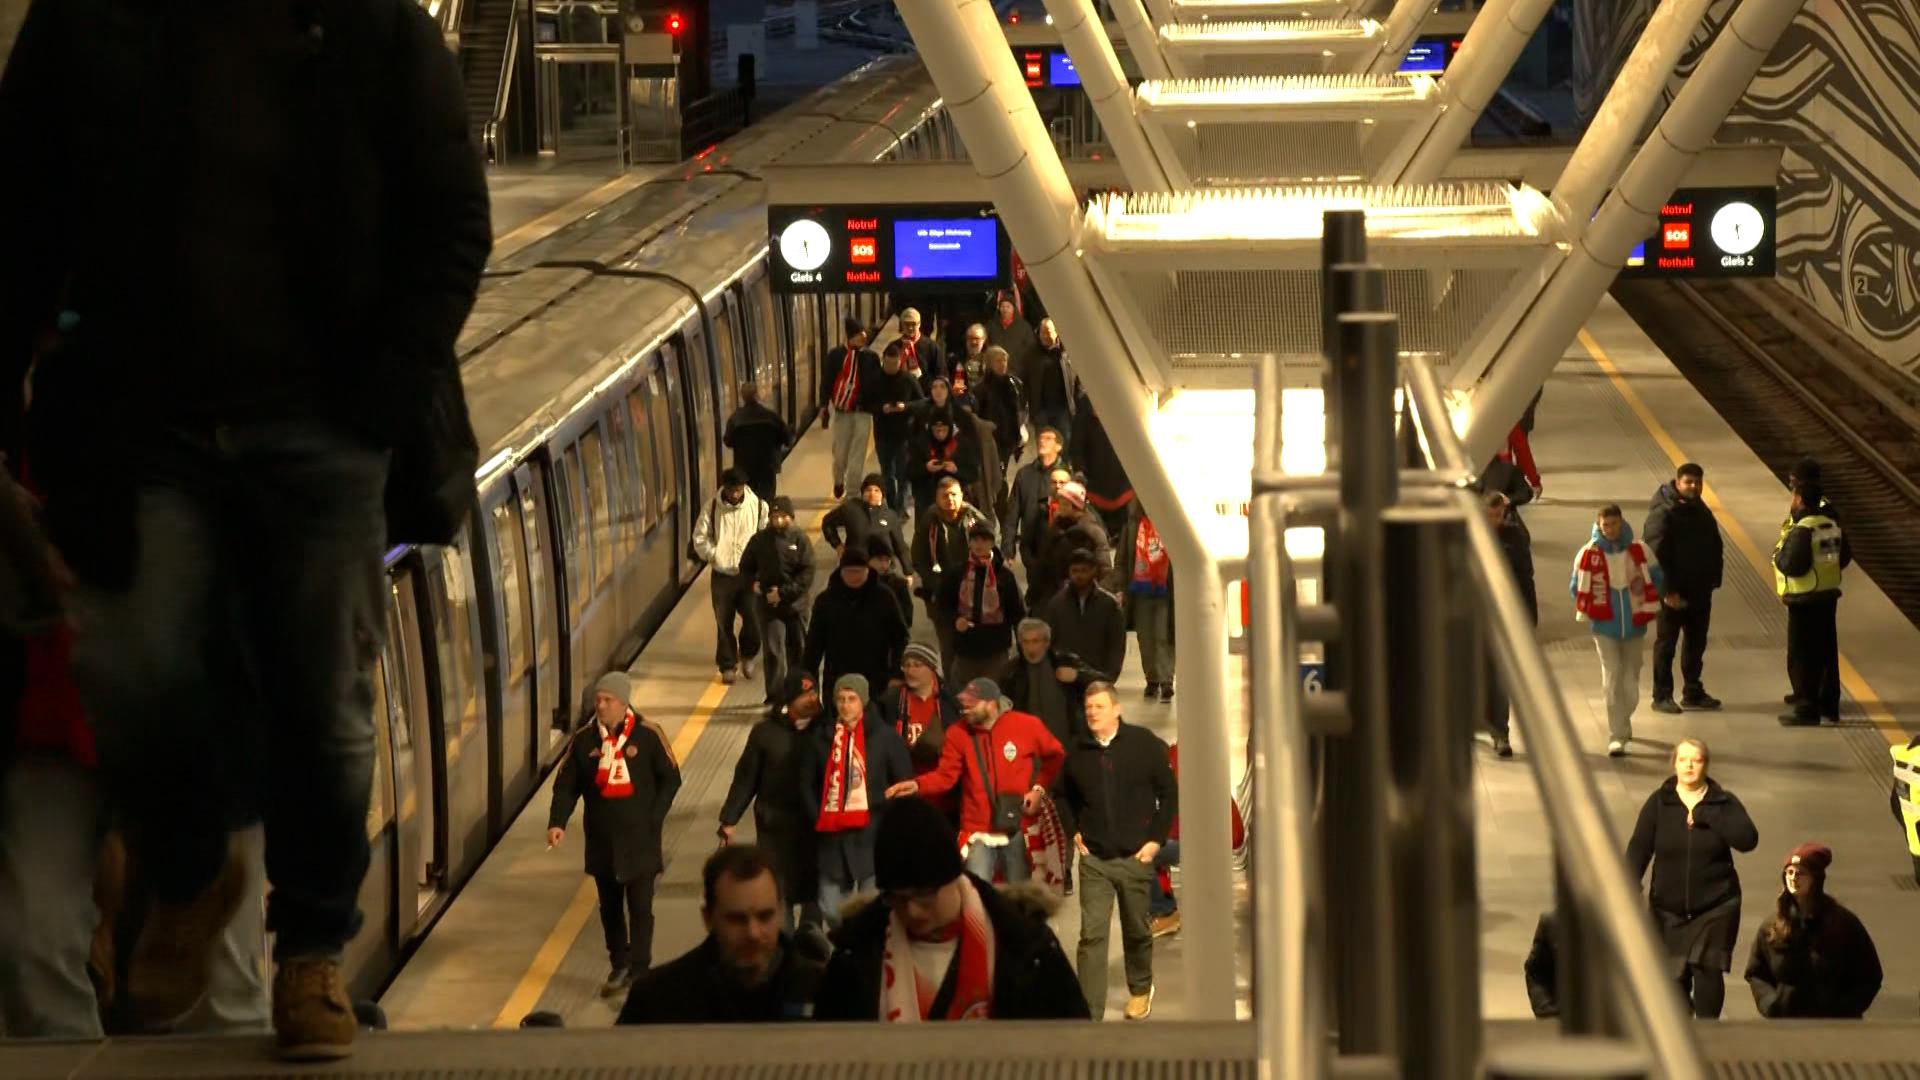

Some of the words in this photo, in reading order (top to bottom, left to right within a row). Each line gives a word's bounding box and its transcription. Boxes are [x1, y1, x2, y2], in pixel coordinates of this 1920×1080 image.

[1661, 203, 1692, 215] Notruf
[847, 219, 877, 230] Notruf
[1666, 230, 1688, 242] SOS
[852, 245, 874, 256] SOS
[1658, 257, 1694, 268] Nothalt
[1720, 255, 1745, 267] Gleis
[1747, 255, 1754, 266] 2
[790, 271, 813, 283] Gleis
[815, 272, 822, 282] 4
[846, 271, 880, 282] Nothalt
[1857, 279, 1865, 294] 2
[1303, 669, 1322, 702] 6
